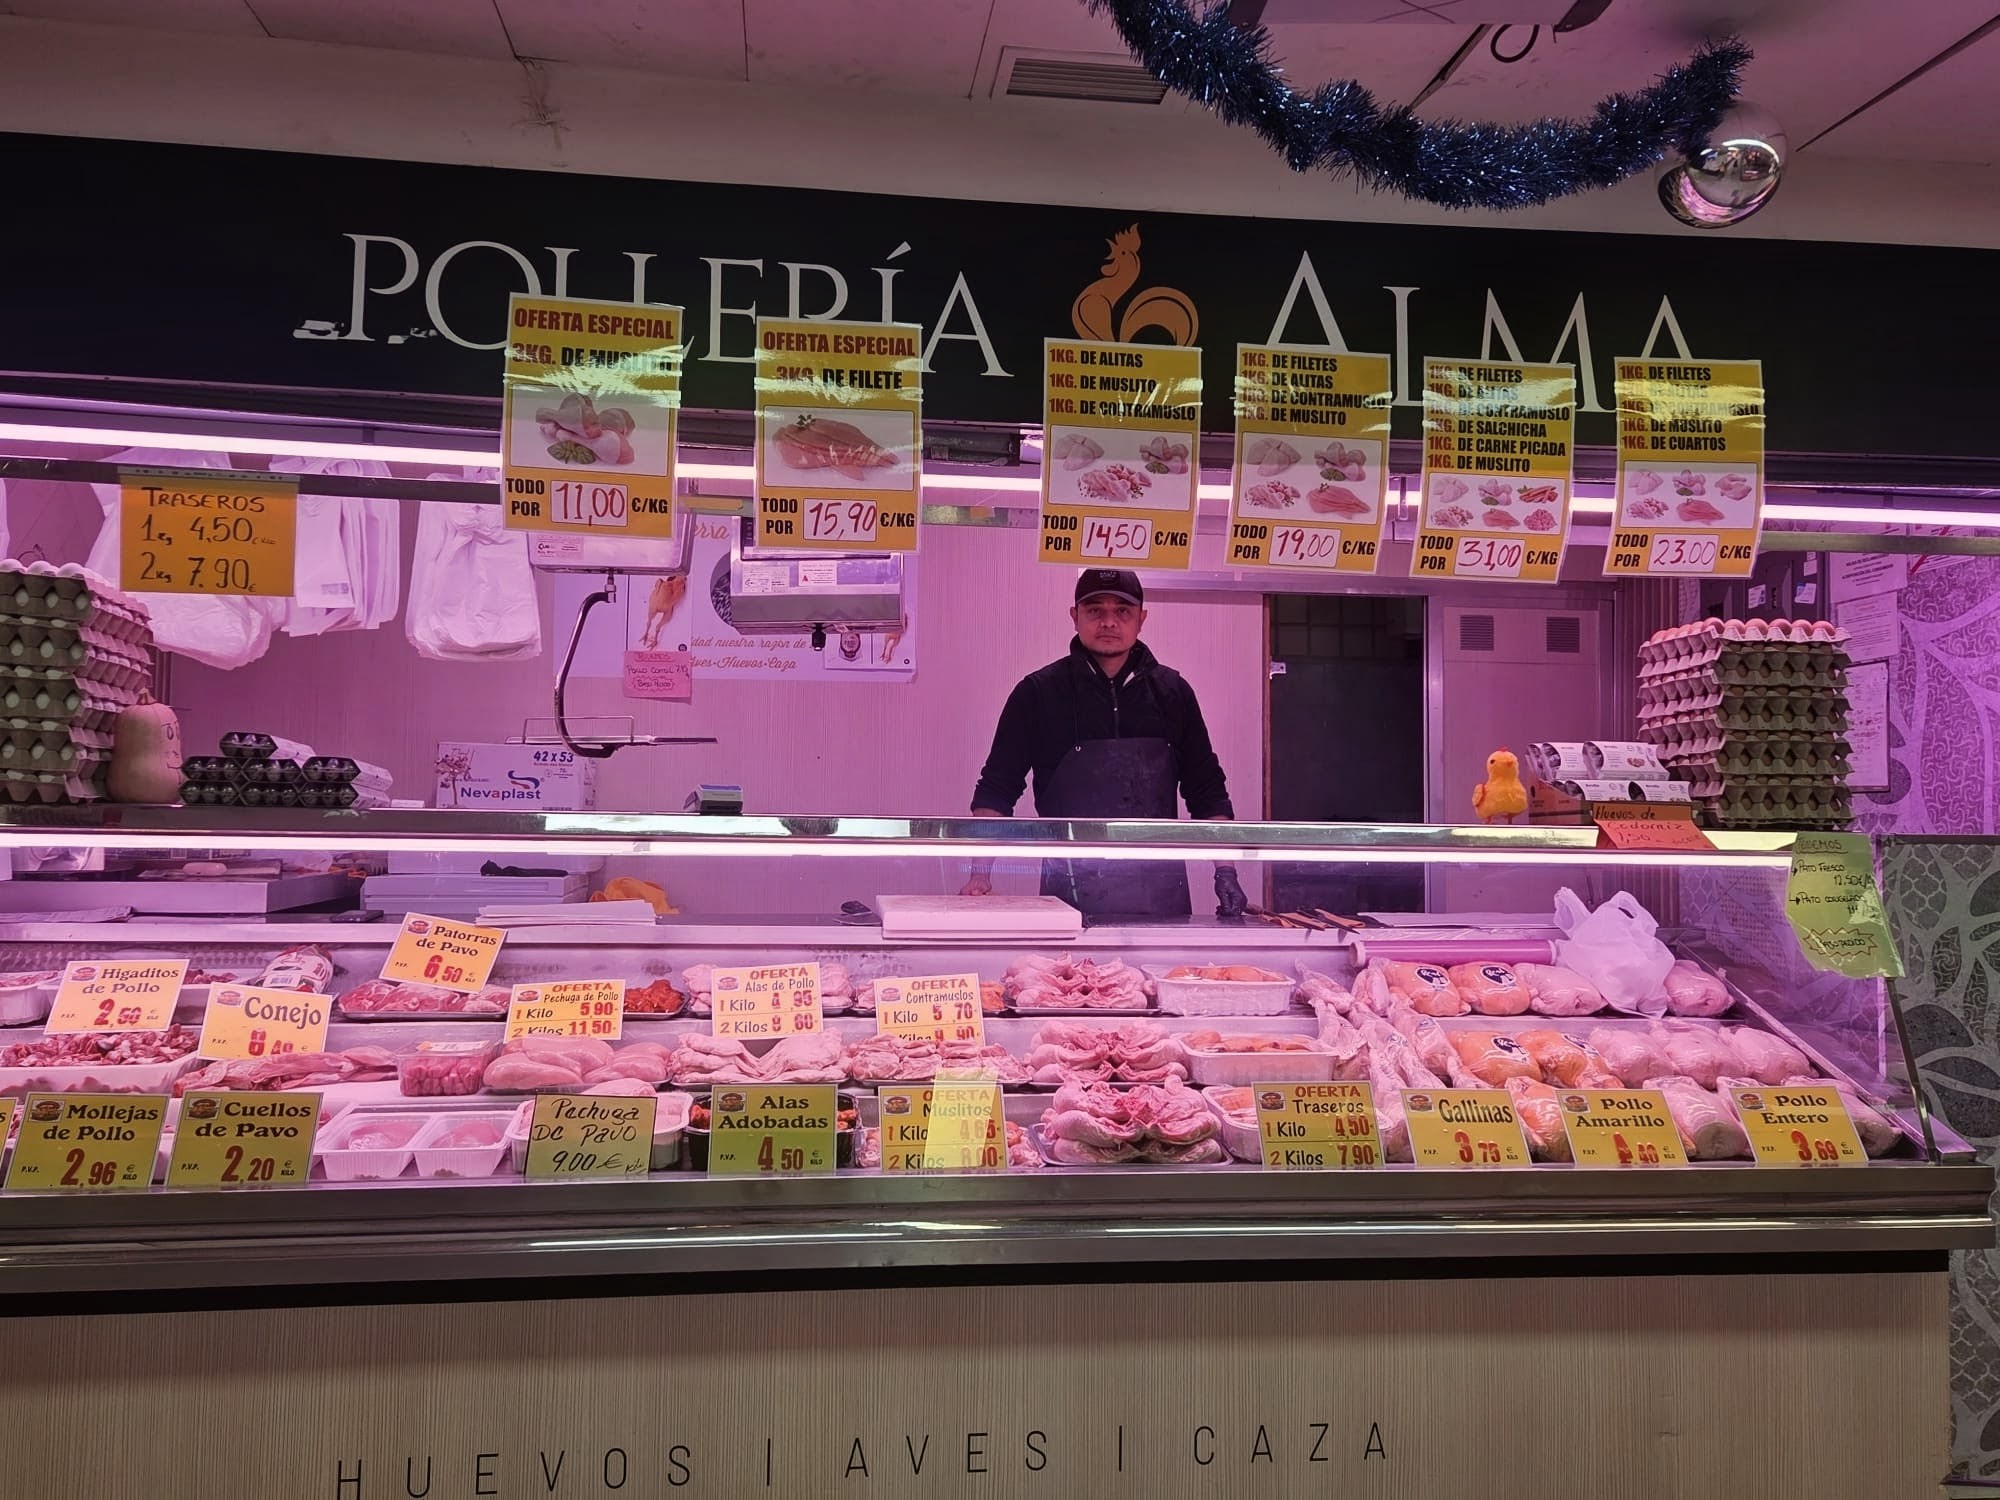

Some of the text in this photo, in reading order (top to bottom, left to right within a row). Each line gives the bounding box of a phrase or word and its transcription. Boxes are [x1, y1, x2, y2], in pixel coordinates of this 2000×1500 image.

[514, 308, 674, 340] OFERTA ESPECIAL
[763, 331, 916, 357] OFERTA ESPECIAL
[1050, 348, 1143, 368] 1KG. DE ALITAS
[1241, 352, 1338, 372] 1KG. DE FILETES
[822, 368, 903, 390] DE FILETE
[1272, 372, 1289, 387] DE
[1290, 373, 1333, 389] ALITAS
[1477, 368, 1523, 383] FILETES
[1620, 366, 1711, 381] 1KG. DE FILETES
[1050, 373, 1157, 394] 1KG. DE MUSLITO
[1049, 398, 1077, 414] 1KG.
[1079, 400, 1096, 415] DE
[1271, 408, 1347, 426] DE MUSLITO
[1458, 420, 1547, 438] DE SALCHICHA
[1669, 420, 1722, 433] MUSLITO
[1428, 436, 1566, 457] 1KG. DE CARNE PICADA
[1622, 436, 1726, 451] 1KG. DE CUARTOS
[1428, 454, 1530, 473] 1KG. DE MUSLITO
[505, 478, 545, 495] TODO
[141, 486, 265, 513] TRASEROS
[555, 482, 668, 526] 11,00 €/KG
[761, 497, 798, 514] TODO
[511, 501, 540, 517] POR
[766, 519, 793, 535] POR
[809, 502, 915, 540] 15,90 €/KG
[1042, 514, 1078, 531] TODO
[1233, 524, 1267, 539] TODO
[1045, 536, 1072, 551] POR
[1085, 522, 1188, 558] 14,50 €/KG
[1277, 529, 1376, 560] 19,00 €/KG
[1420, 535, 1454, 550] TODO
[1615, 534, 1648, 548] TODO
[1233, 545, 1260, 559] POR
[1458, 541, 1558, 571] 31,00 €/KG
[1720, 545, 1751, 559] €/KG
[1420, 556, 1446, 570] POR
[1614, 554, 1640, 567] POR
[533, 751, 574, 763] 42 53
[461, 786, 541, 802] Nevaplast
[1595, 806, 1656, 820] Huevos de
[434, 924, 497, 945] Patorras
[416, 938, 478, 957] de Pavo
[101, 968, 180, 981] Higaditos
[750, 967, 808, 980] OFERTA
[82, 983, 160, 994] de Pollo
[552, 983, 612, 992] OFERTA
[745, 978, 814, 993] Alas de Pollo
[911, 979, 968, 990] OFERTA
[544, 993, 582, 1004] Pechuga
[598, 991, 619, 1001] Pollo
[719, 999, 756, 1011] 1 Kilo
[906, 991, 974, 1004] Contramuslos
[244, 997, 322, 1029] Conejo
[515, 1010, 522, 1020] 1
[526, 1008, 553, 1019] Kilo
[883, 1012, 889, 1024] 1
[893, 1011, 919, 1023] Kilo
[512, 1028, 523, 1038] 2
[720, 1021, 768, 1033] 2 Kilos
[923, 1090, 990, 1101] OFERTA
[1295, 1086, 1360, 1097] OFERTA
[760, 1096, 809, 1109] Alas
[1292, 1100, 1364, 1114] Traseros
[1602, 1099, 1653, 1111] Pollo
[1775, 1095, 1828, 1107] Pollo
[67, 1104, 158, 1123] Mollejas
[224, 1102, 312, 1118] Cuellos
[551, 1098, 639, 1123] Pechuga
[923, 1103, 991, 1117] Muslitos
[1439, 1099, 1513, 1124] Gallinas
[718, 1116, 828, 1129] Adobadas
[1576, 1115, 1665, 1128] Amarillo
[1764, 1112, 1829, 1124] Entero
[43, 1126, 135, 1141] de Pollo
[195, 1122, 299, 1138] de Pavo
[900, 1125, 928, 1141] Kilo
[1266, 1123, 1272, 1137] 1
[1276, 1122, 1306, 1138] Kilo
[889, 1154, 944, 1169] 2 Kilos
[1270, 1150, 1323, 1166] 2 Kilos
[337, 1421, 1387, 1500] HUEVOS AVES CAZA
